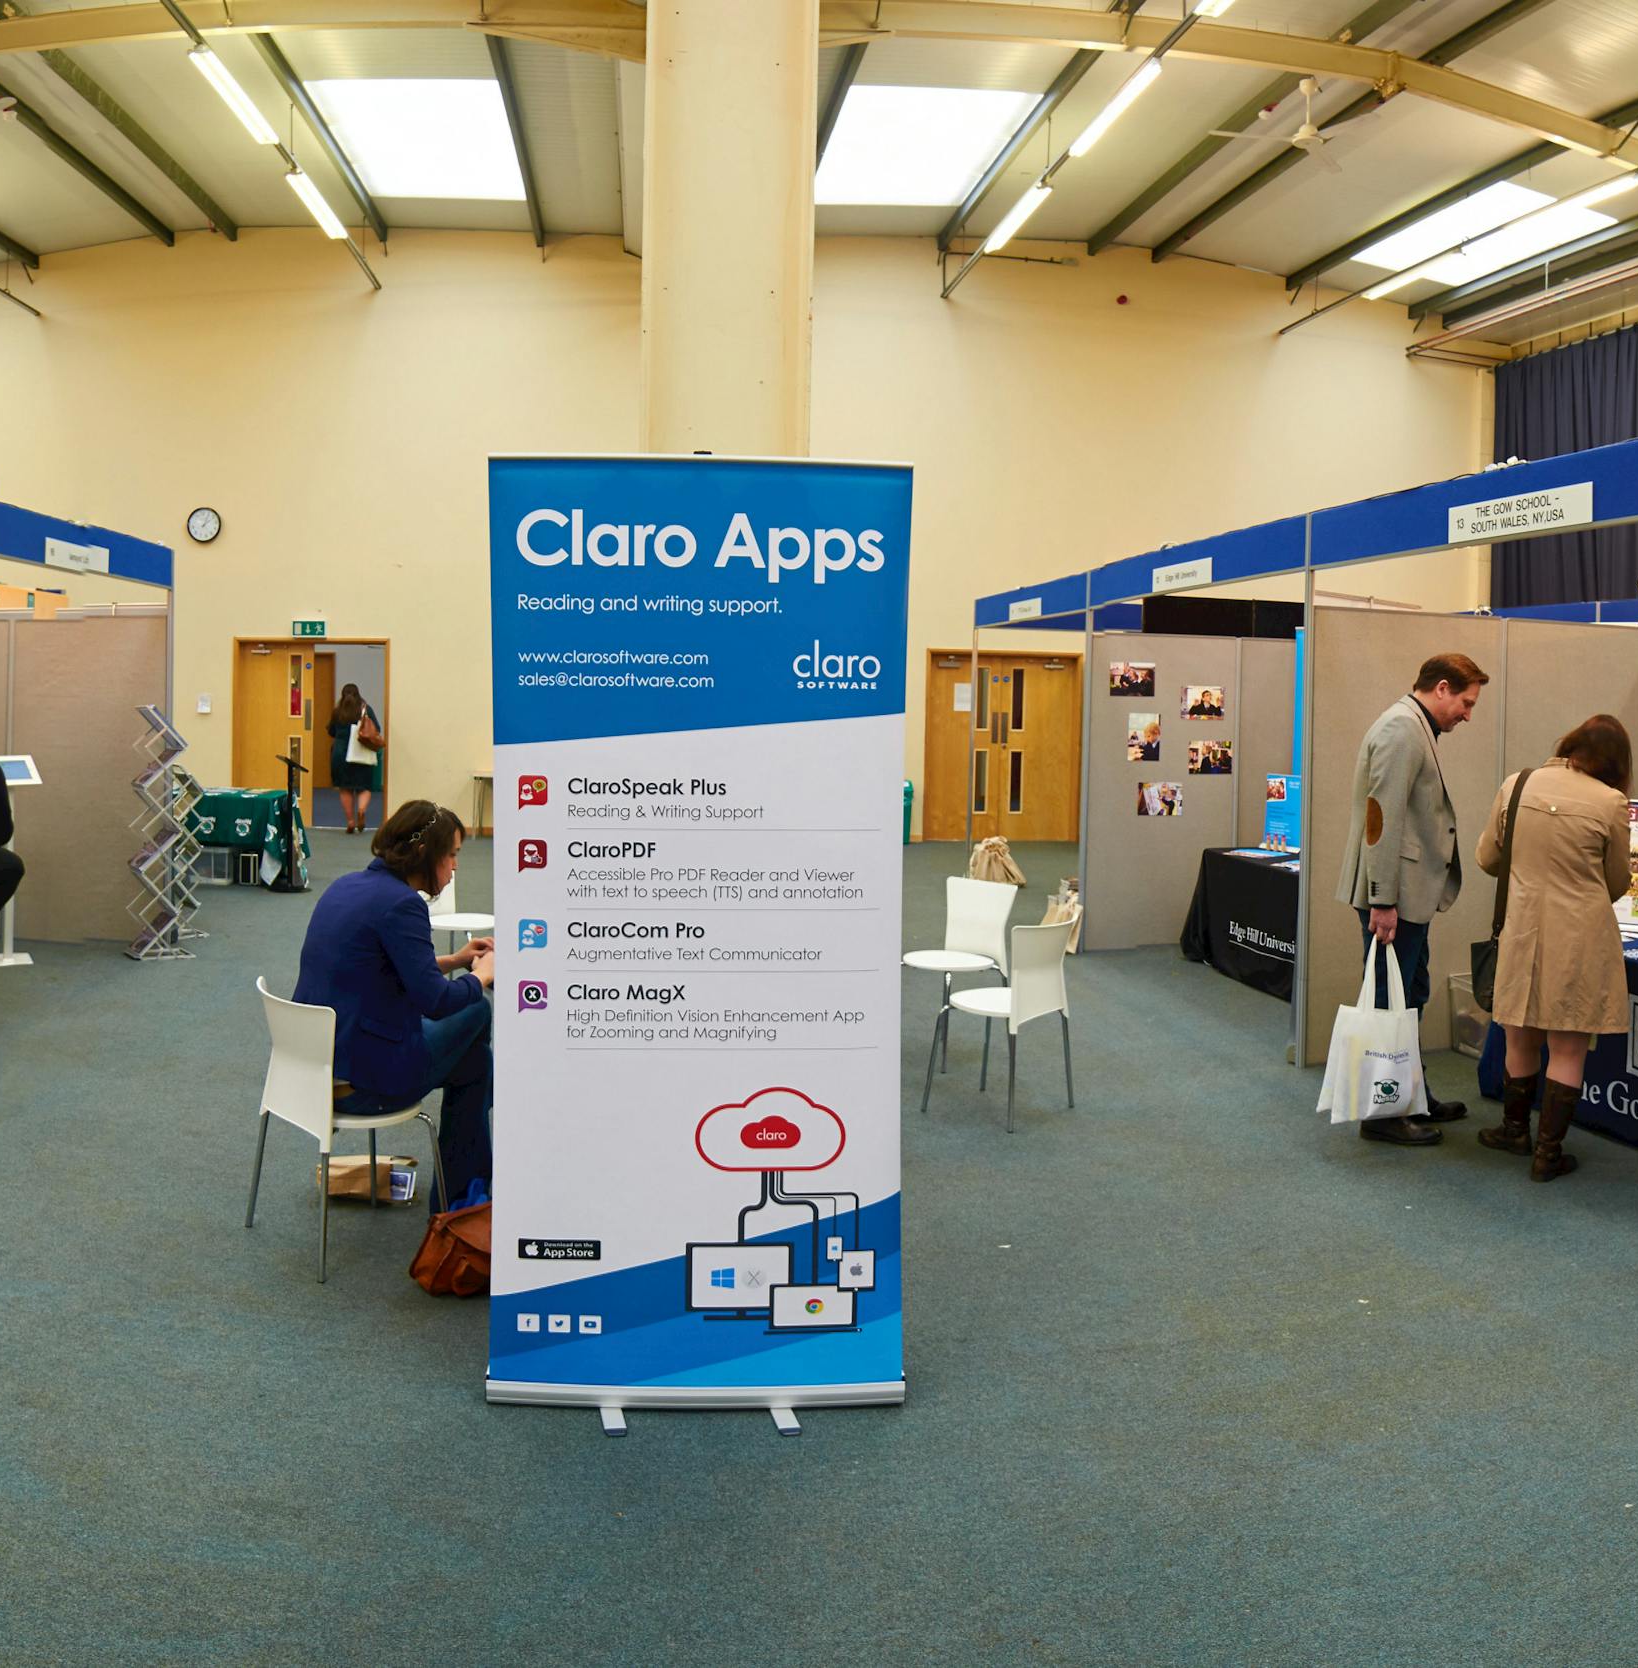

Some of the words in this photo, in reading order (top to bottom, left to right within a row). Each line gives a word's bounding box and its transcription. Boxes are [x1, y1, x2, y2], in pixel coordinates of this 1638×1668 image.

[1475, 507, 1491, 518] THE
[1493, 501, 1513, 514] GOW
[1516, 494, 1551, 511] SCHOOL
[1456, 518, 1464, 529] 13
[1470, 519, 1498, 534] SOUTH
[1501, 514, 1530, 529] WALES,
[1532, 508, 1565, 524] NY,USA
[516, 508, 697, 567] Claro
[714, 512, 885, 584] Apps
[517, 593, 594, 615] Reading
[600, 594, 638, 613] and
[643, 595, 704, 616] writing
[708, 597, 783, 616] support.
[518, 649, 709, 666] www.clarosoftware.com
[792, 639, 881, 679] claro
[518, 672, 714, 688] sales@clarosoftware.com
[796, 680, 878, 690] SOFTWARE
[567, 777, 684, 800] ClaroSpeak
[690, 778, 727, 796] Plus
[567, 804, 631, 821] Reading
[635, 805, 647, 819] &
[651, 804, 701, 821] Writing
[705, 804, 764, 820] Support
[567, 841, 657, 859] ClaroPDF
[566, 867, 646, 882] Accessible
[650, 868, 674, 882] Pro
[678, 868, 706, 881] PDF
[710, 868, 765, 882] Reader
[769, 868, 800, 882] and
[803, 868, 854, 882] Viewer
[566, 885, 598, 899] with
[601, 885, 629, 898] text
[633, 885, 649, 898] to
[652, 885, 708, 901] speech
[712, 884, 743, 901] (TTS)
[748, 885, 778, 898] and
[782, 885, 863, 899] annotation
[567, 922, 669, 939] ClaroCom
[676, 922, 705, 939] Pro
[1229, 920, 1246, 942] Edge
[1246, 927, 1259, 944] Hill
[1259, 931, 1295, 954] Universi
[566, 947, 673, 963] Augmentative
[677, 947, 704, 961] Text
[708, 947, 823, 961] Communicator
[567, 984, 620, 1001] Claro
[626, 985, 686, 1004] MagX
[566, 1008, 600, 1025] High
[604, 1008, 673, 1023] Definition
[677, 1009, 719, 1023] Vision
[723, 1009, 829, 1023] Enhancement
[833, 1010, 865, 1026] App
[566, 1025, 586, 1039] for
[589, 1025, 654, 1042] Zooming
[658, 1026, 689, 1040] and
[693, 1025, 777, 1042] Magnifying
[756, 1127, 787, 1141] claro
[543, 1248, 565, 1258] App
[566, 1248, 594, 1257] Store
